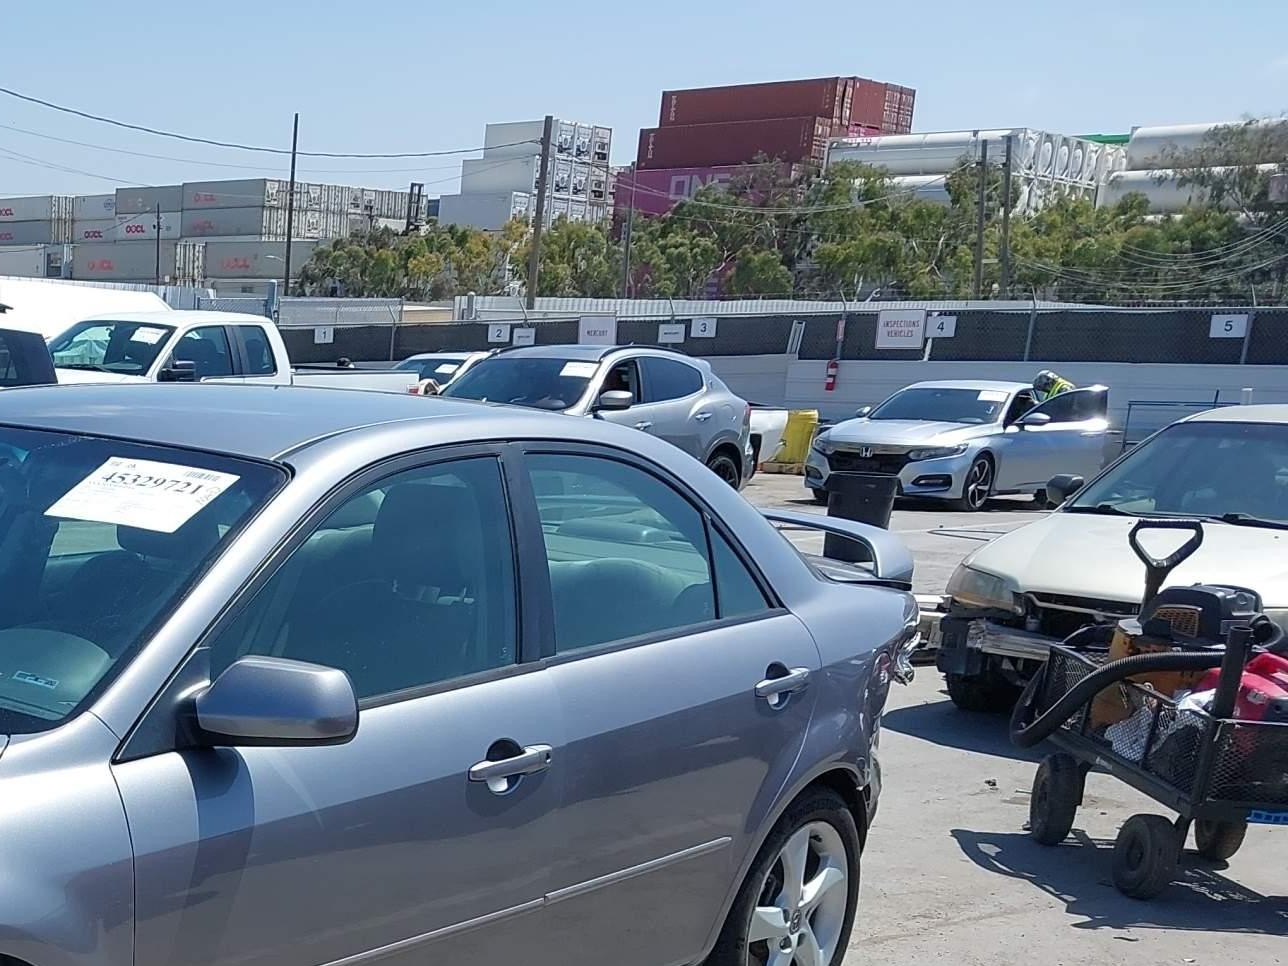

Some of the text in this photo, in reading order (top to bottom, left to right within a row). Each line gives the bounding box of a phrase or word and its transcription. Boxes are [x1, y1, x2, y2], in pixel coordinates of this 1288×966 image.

[125, 225, 145, 234] OOCL
[84, 230, 103, 239] OOCL
[700, 322, 707, 333] 3
[883, 320, 920, 328] INSPECTIONS
[937, 321, 945, 332] 4
[1224, 320, 1233, 332] 5
[496, 329, 502, 338] 2
[887, 329, 914, 337] VEHICLES
[101, 471, 204, 495] 45329721
